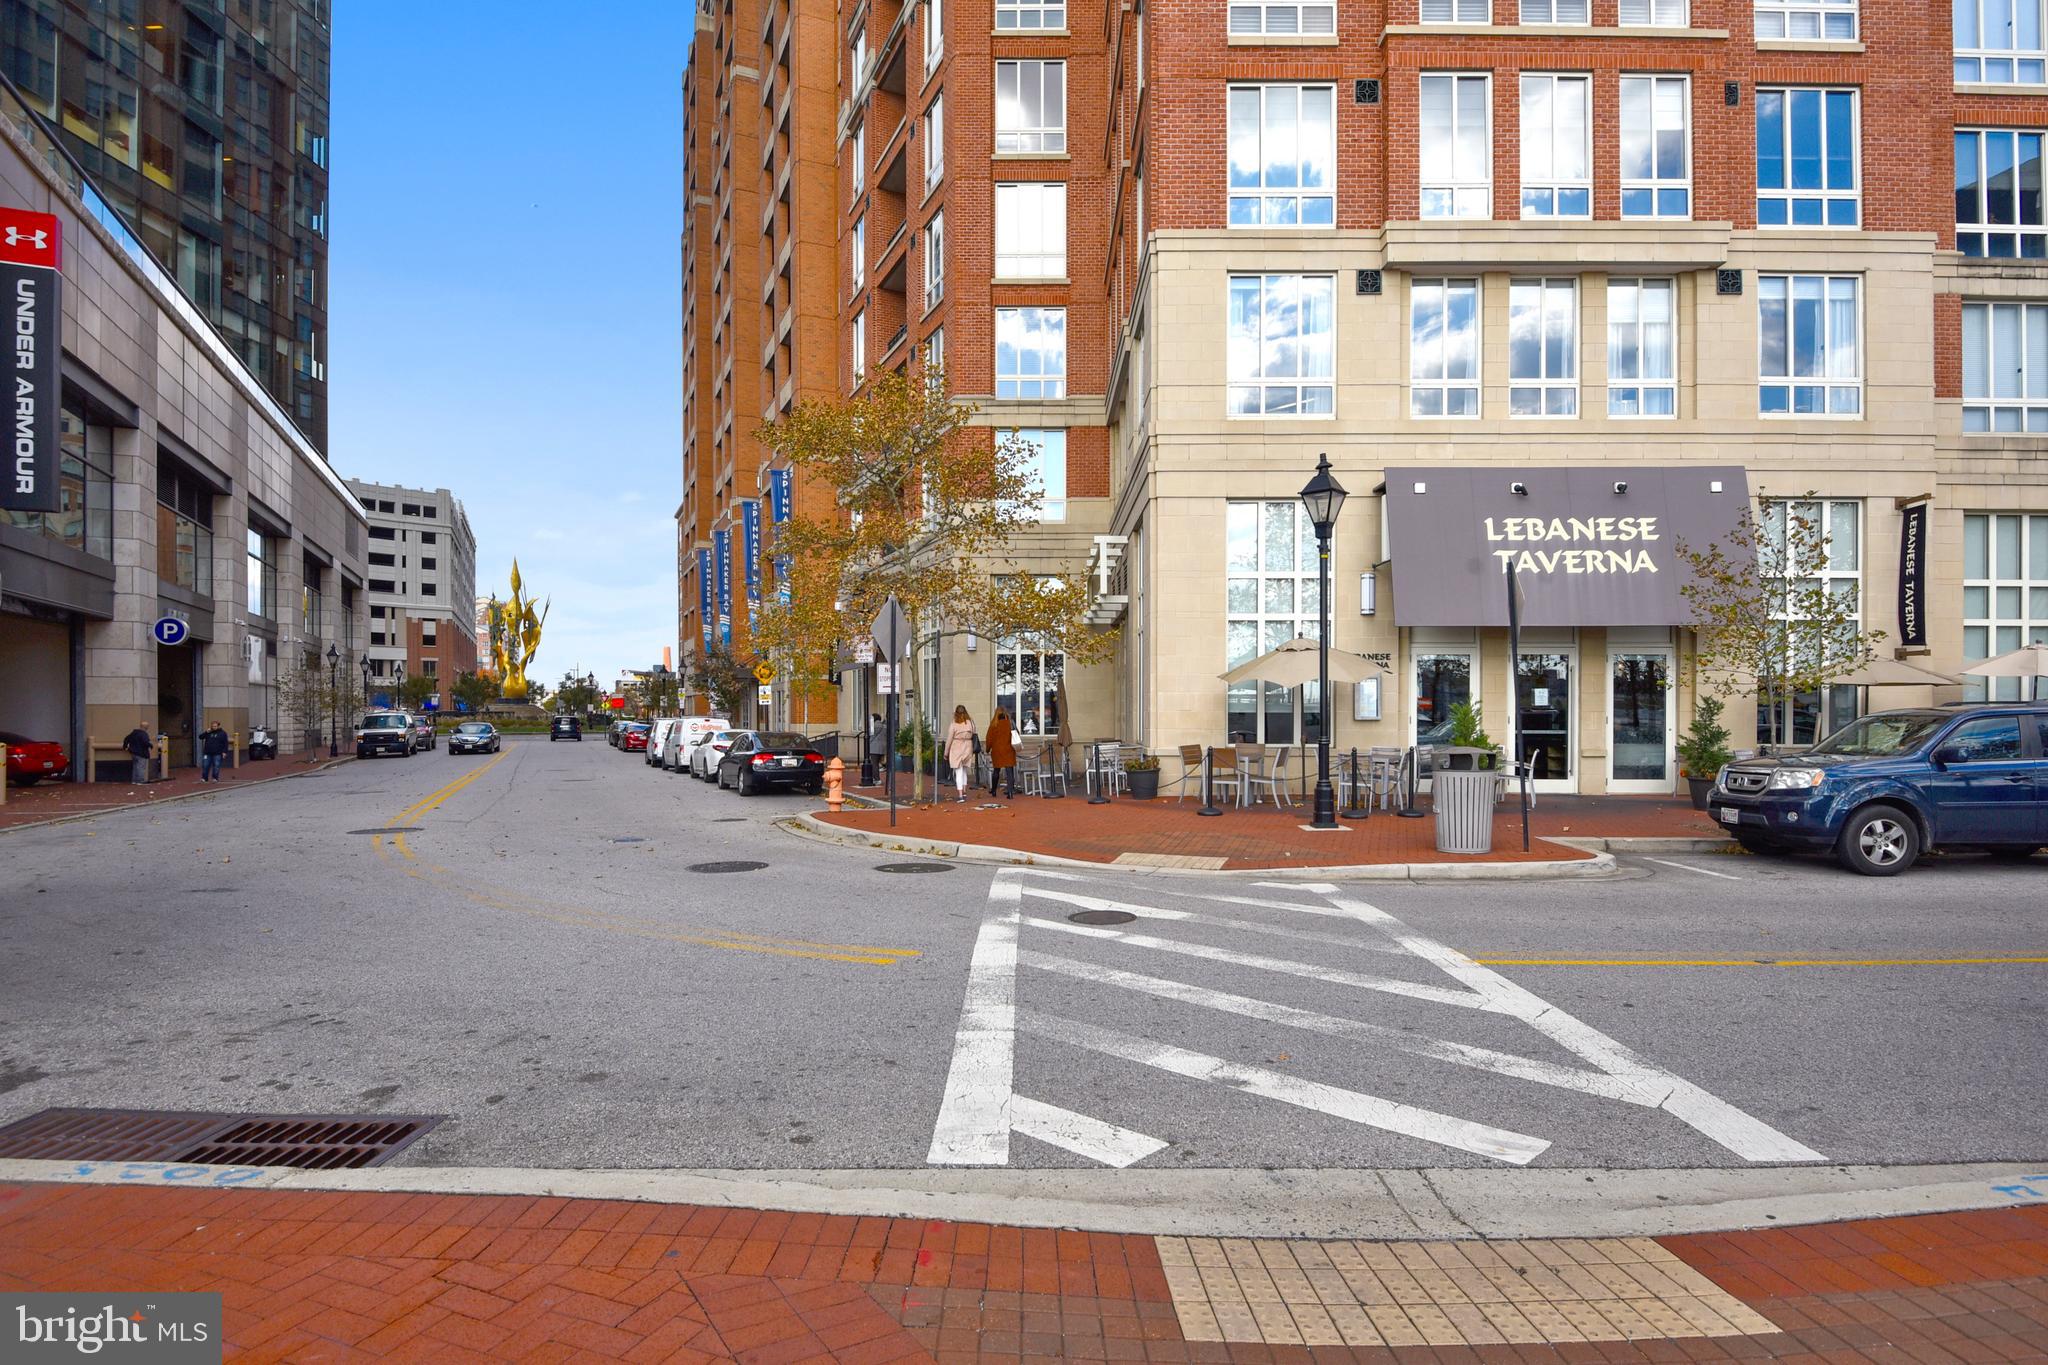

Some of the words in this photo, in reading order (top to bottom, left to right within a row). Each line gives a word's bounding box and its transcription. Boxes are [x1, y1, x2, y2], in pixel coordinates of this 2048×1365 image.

[15, 278, 36, 370] UNDER
[15, 376, 35, 494] ARMOUR
[1483, 516, 1661, 542] LEBANESE
[1905, 512, 1919, 576] LEBANESE
[1492, 548, 1659, 575] TAVERNA
[163, 622, 179, 640] P
[1904, 580, 1917, 640] TAVERNA
